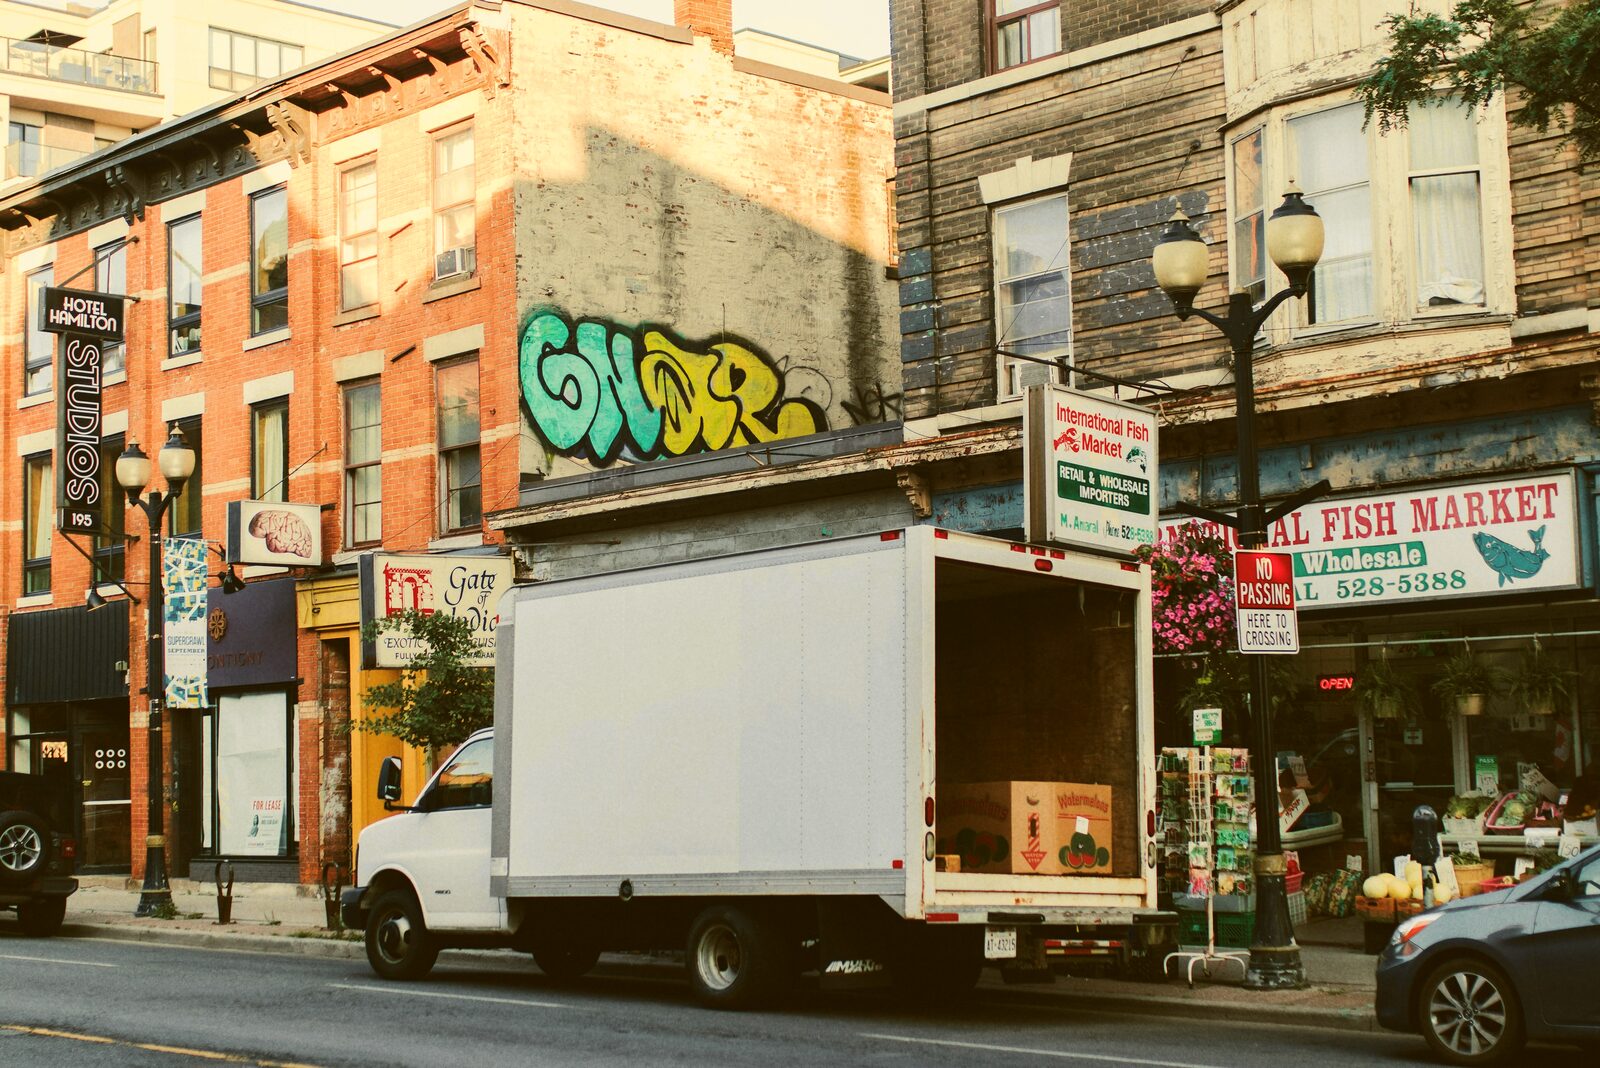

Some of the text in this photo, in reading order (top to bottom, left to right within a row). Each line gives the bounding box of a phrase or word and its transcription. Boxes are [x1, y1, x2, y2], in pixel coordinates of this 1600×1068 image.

[63, 296, 107, 317] HOTEL
[49, 309, 117, 332] HAMILTON
[66, 339, 100, 504] STUDIOS
[1056, 402, 1149, 442] International Fish
[1081, 432, 1123, 459] Market
[1059, 465, 1148, 496] RETAIL & WHOLESALE
[1079, 485, 1130, 507] IMPORTERS
[72, 512, 93, 527] 195
[1320, 501, 1397, 543] FISH
[1410, 482, 1559, 533] MARKET
[1256, 557, 1273, 580] NO
[1301, 543, 1422, 575] Wholesale
[444, 566, 497, 606] Gate
[1240, 582, 1291, 606] PASSING
[1336, 569, 1467, 599] 528-5388
[1247, 613, 1287, 629] HERE TO
[167, 635, 206, 646] SUPERCRAWL
[384, 637, 425, 649] EXOTIC
[1245, 631, 1292, 646] CROSSING
[1320, 677, 1354, 690] OPEN
[252, 799, 282, 810] FOR LEASE
[1056, 791, 1109, 814] Watermelons
